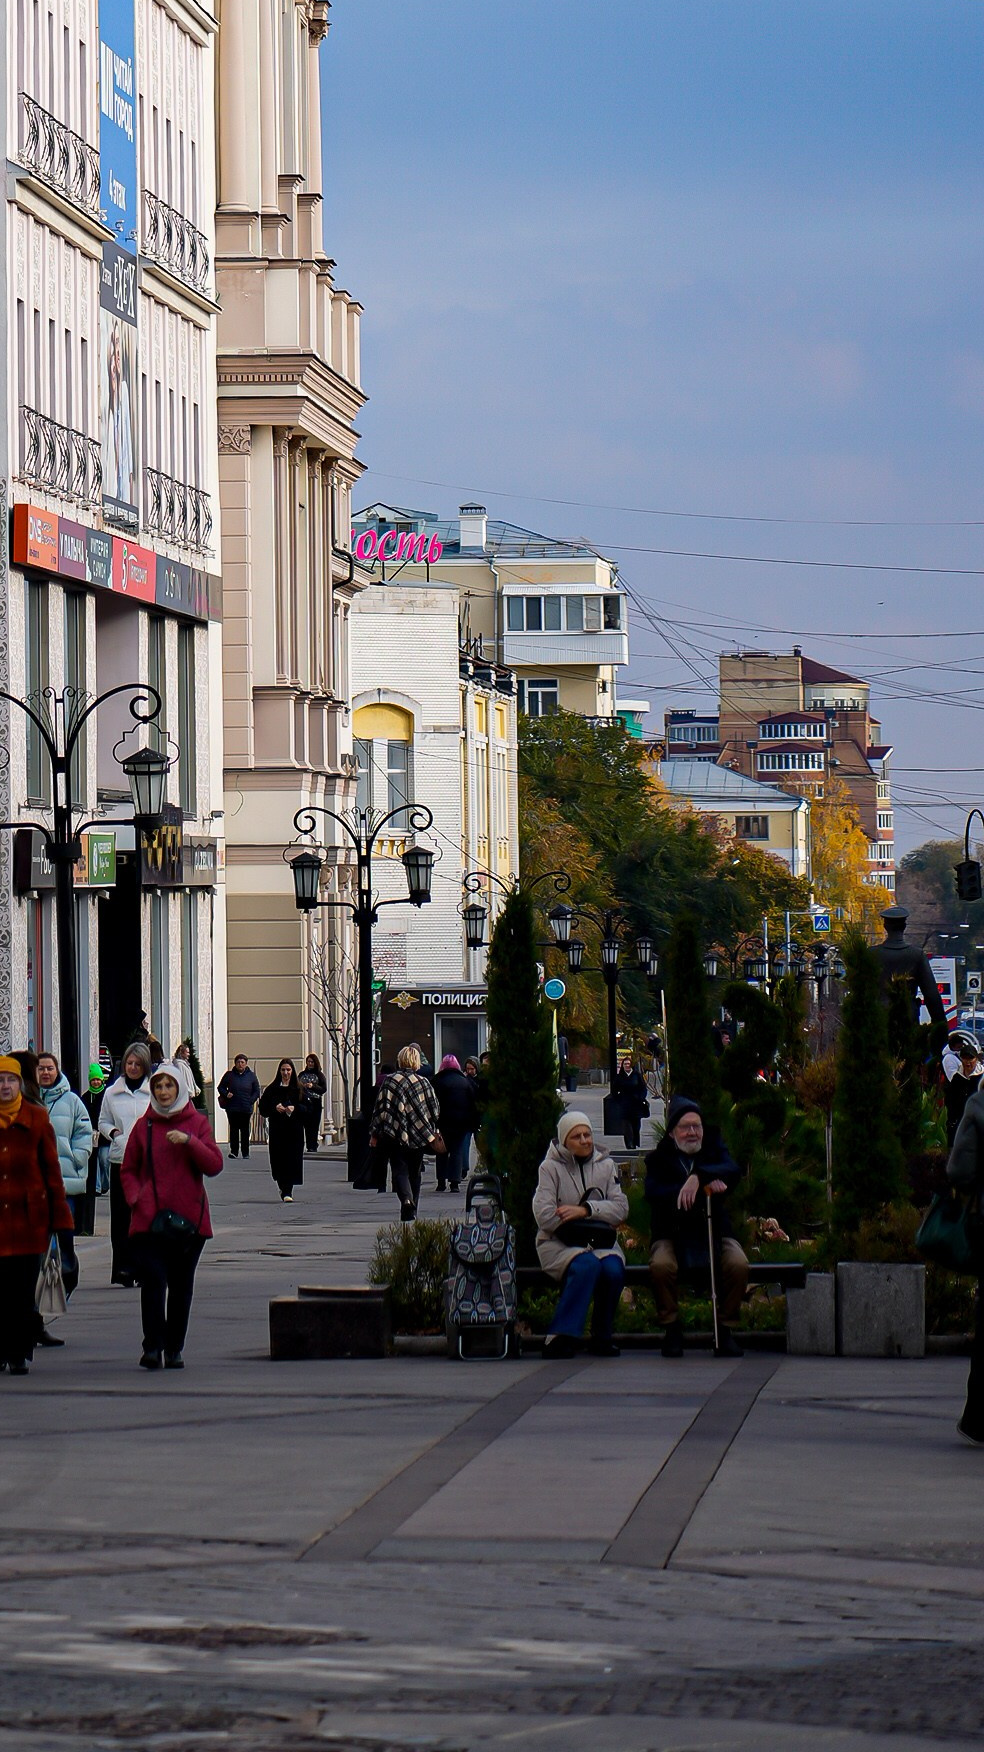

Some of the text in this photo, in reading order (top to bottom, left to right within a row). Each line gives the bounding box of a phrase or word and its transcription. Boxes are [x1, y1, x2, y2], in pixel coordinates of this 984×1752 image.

[113, 53, 133, 98] ЧИТАЙ
[114, 92, 134, 143] ГОРОД
[351, 529, 444, 563] ость
[422, 993, 489, 1008] ПОЛИЦИЯ
